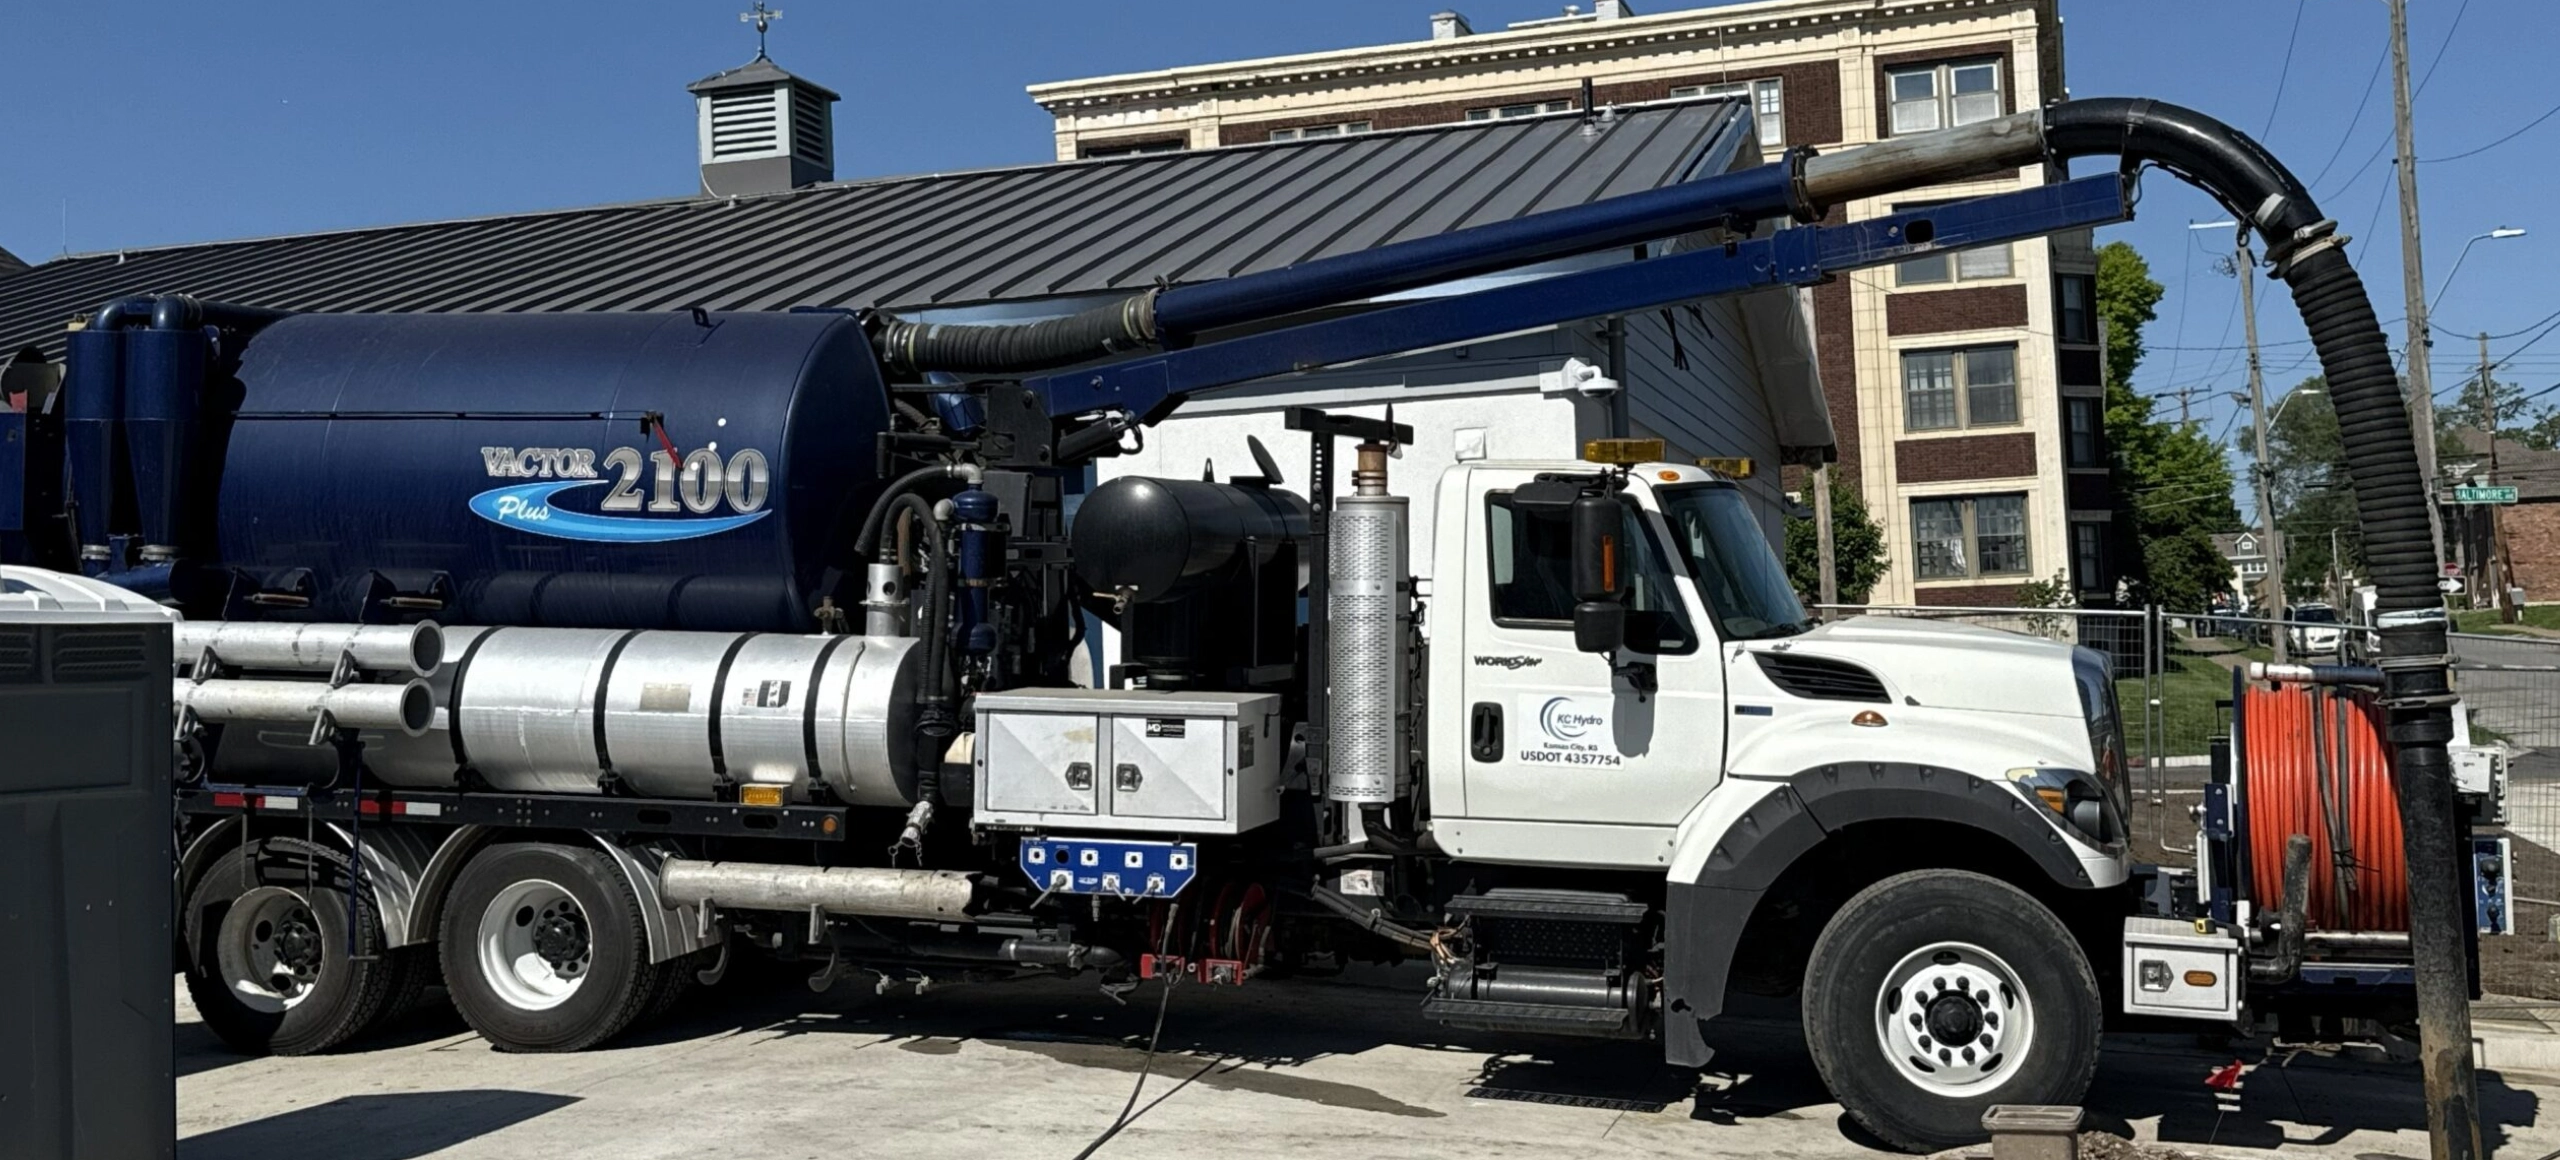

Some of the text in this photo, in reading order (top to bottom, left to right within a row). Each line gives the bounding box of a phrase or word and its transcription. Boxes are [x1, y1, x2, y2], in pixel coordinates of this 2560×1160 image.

[481, 446, 770, 514] VACTOR 2100
[2455, 488, 2504, 500] BALTIMORE
[498, 496, 550, 521] Plus
[1557, 714, 1603, 726] KC Hydro
[1521, 750, 1621, 766] USDOT 4357754
